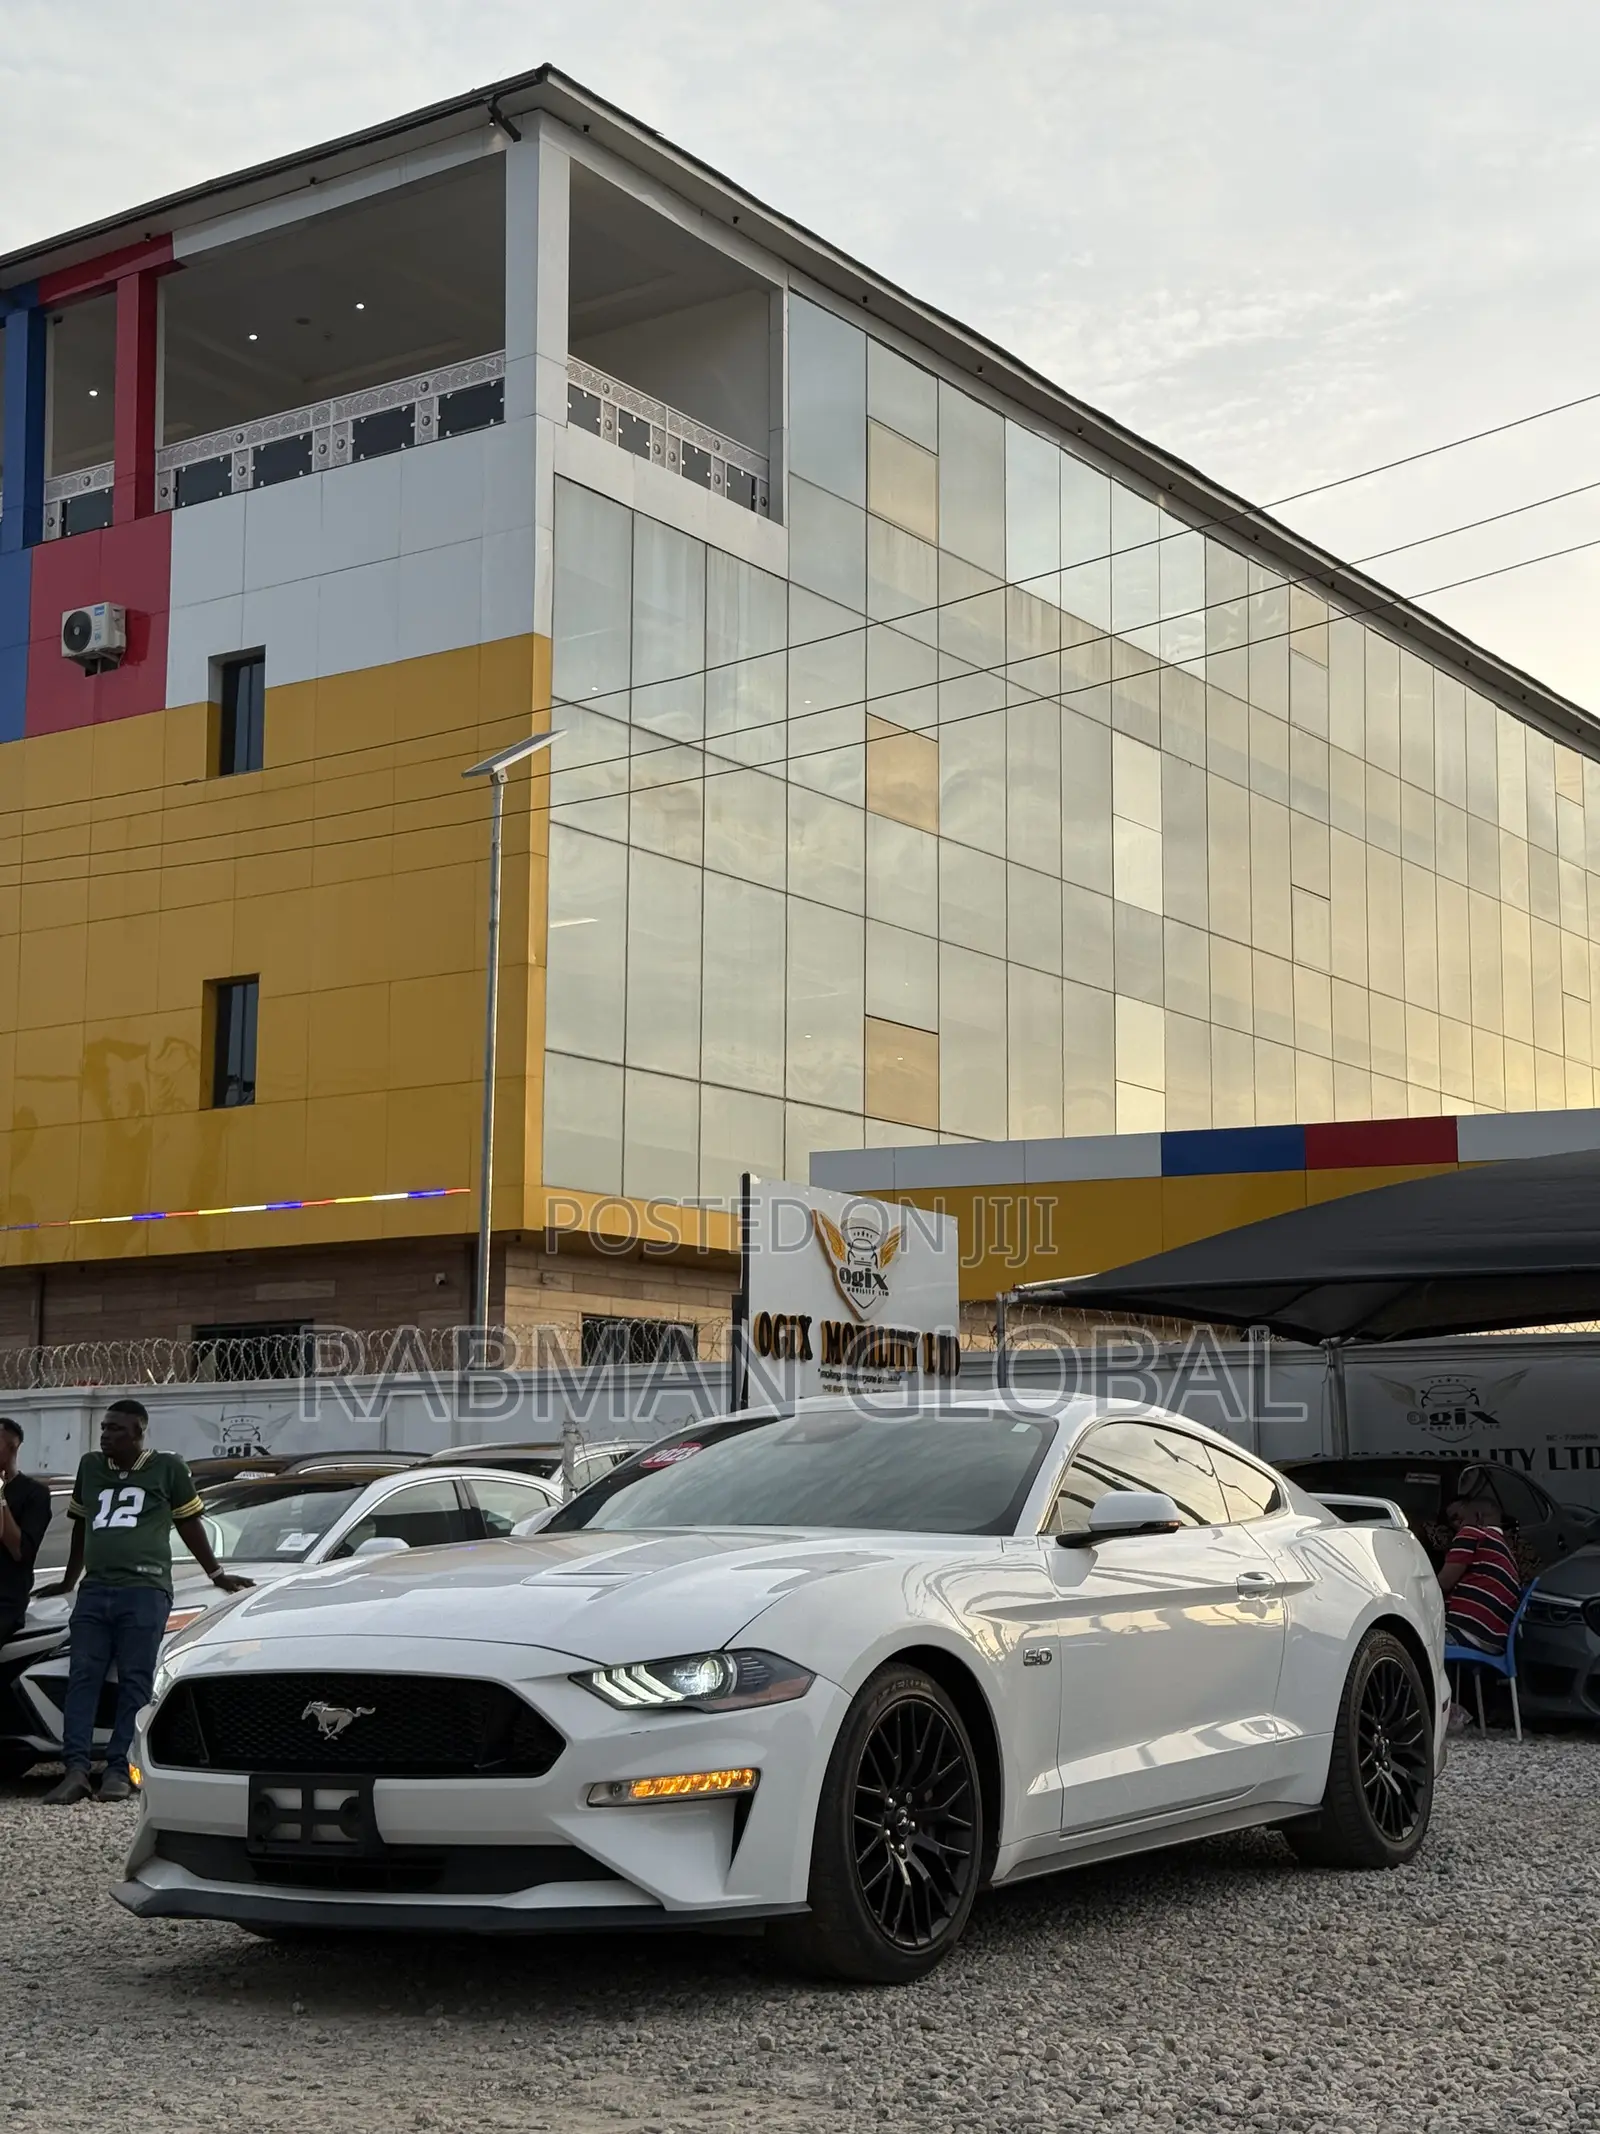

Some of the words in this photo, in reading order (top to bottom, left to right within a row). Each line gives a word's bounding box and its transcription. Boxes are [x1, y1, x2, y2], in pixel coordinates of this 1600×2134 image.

[839, 1267, 889, 1291] ogix
[754, 1311, 813, 1361] OGIX
[1548, 1446, 1600, 1471] LTD
[92, 1486, 146, 1529] 12
